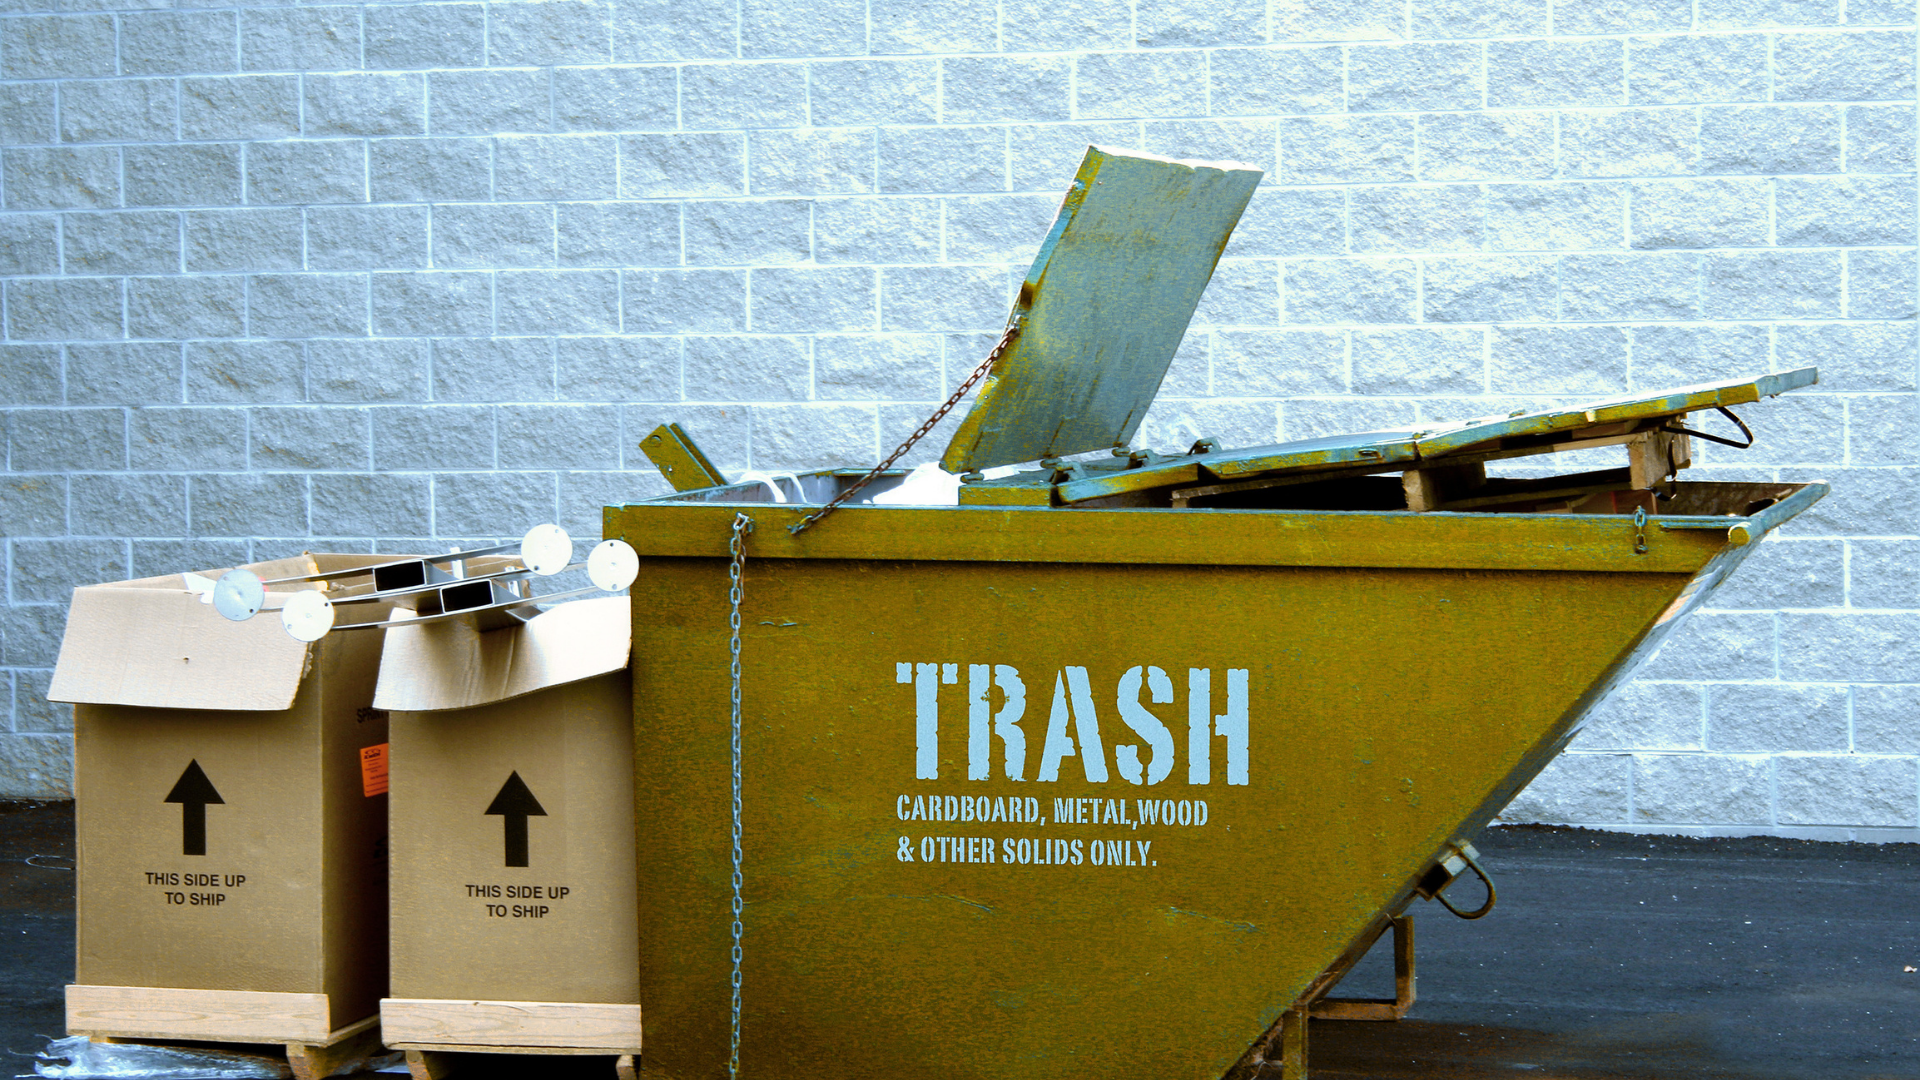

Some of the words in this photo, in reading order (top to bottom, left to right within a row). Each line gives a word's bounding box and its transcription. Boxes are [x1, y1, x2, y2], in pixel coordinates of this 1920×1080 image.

[896, 663, 1248, 785] TRASH
[897, 795, 1045, 826] CARDBOARD,
[897, 836, 914, 862] &
[921, 837, 994, 863] OTHER
[1003, 838, 1083, 865] SOLIDS
[1091, 840, 1156, 866] ONLY.
[145, 872, 179, 885] THIS
[184, 874, 219, 886] SIDE
[225, 875, 245, 887] UP
[165, 892, 185, 905] TO
[190, 893, 225, 905] SHIP
[465, 885, 501, 897] THIS
[507, 886, 543, 898] SIDE
[548, 887, 569, 899] UP
[486, 905, 507, 917] TO
[513, 905, 549, 918] SHIP
